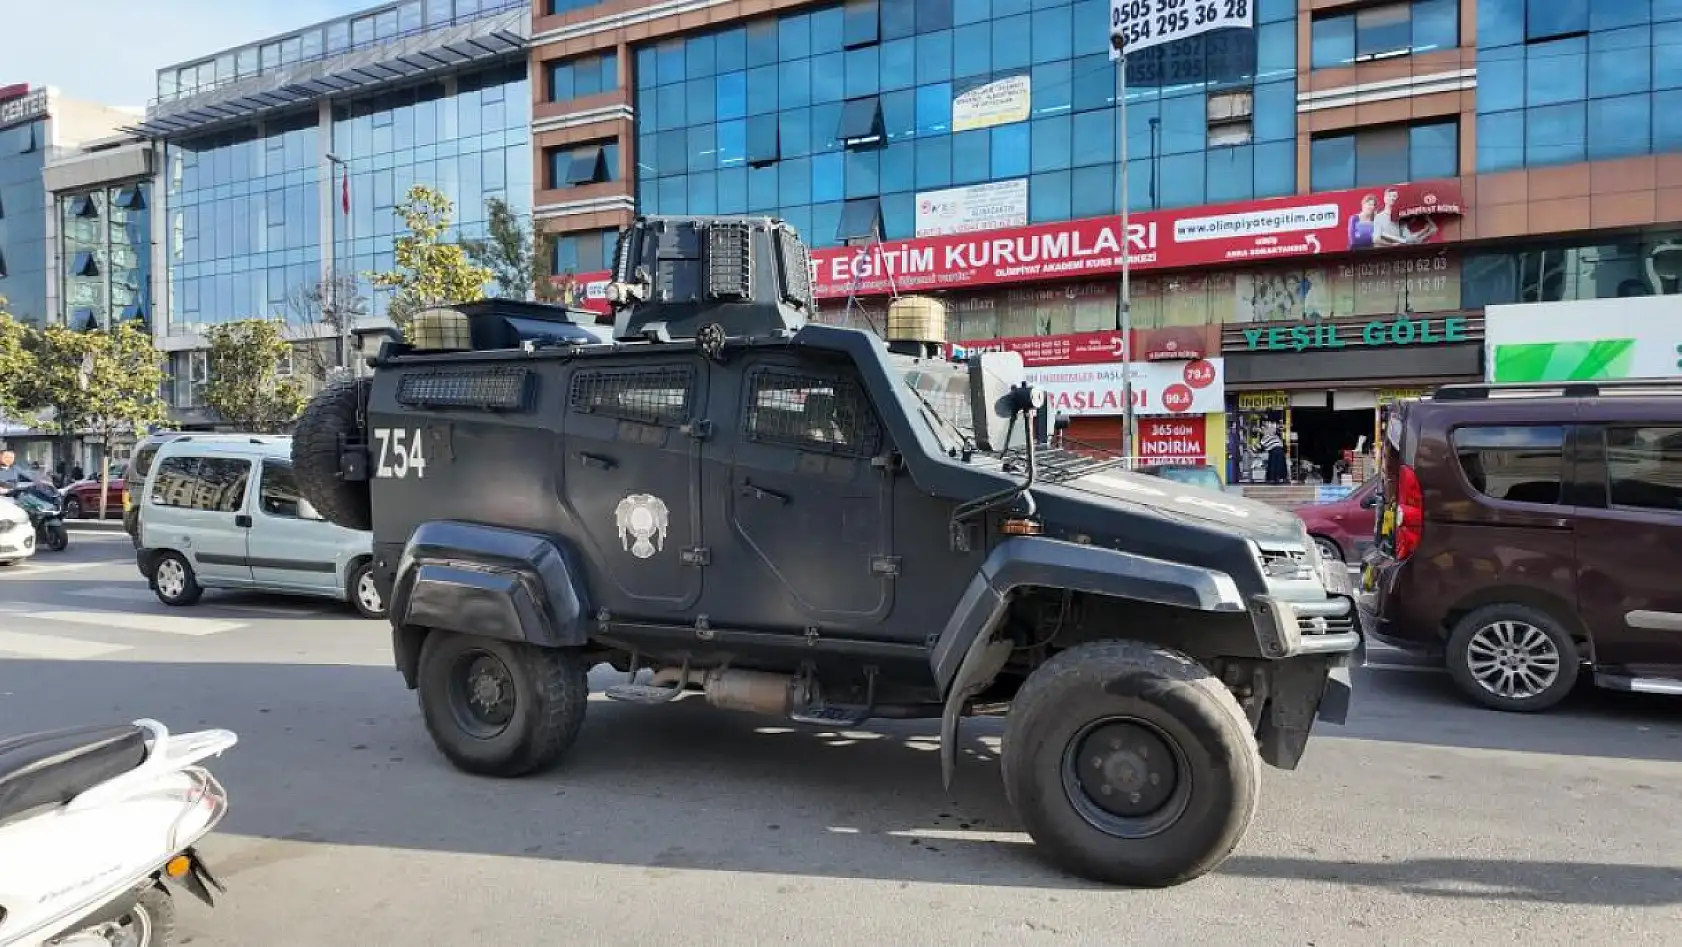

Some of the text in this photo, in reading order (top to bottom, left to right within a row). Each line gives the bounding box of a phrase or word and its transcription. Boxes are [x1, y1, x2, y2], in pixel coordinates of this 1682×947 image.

[1113, 0, 1150, 27] 0505
[1122, 20, 1150, 45] 554
[1156, 9, 1189, 36] 295
[1195, 2, 1218, 26] 36
[1224, 0, 1248, 19] 28
[1177, 210, 1336, 235] www.olimpiyategitim.com
[831, 243, 934, 281] EĞİTİM
[945, 222, 1157, 269] KURUMLARI
[1242, 313, 1469, 353] YEŞİL GÖLE
[373, 427, 427, 479] Z54
[1141, 435, 1201, 454] İNDİRİM
